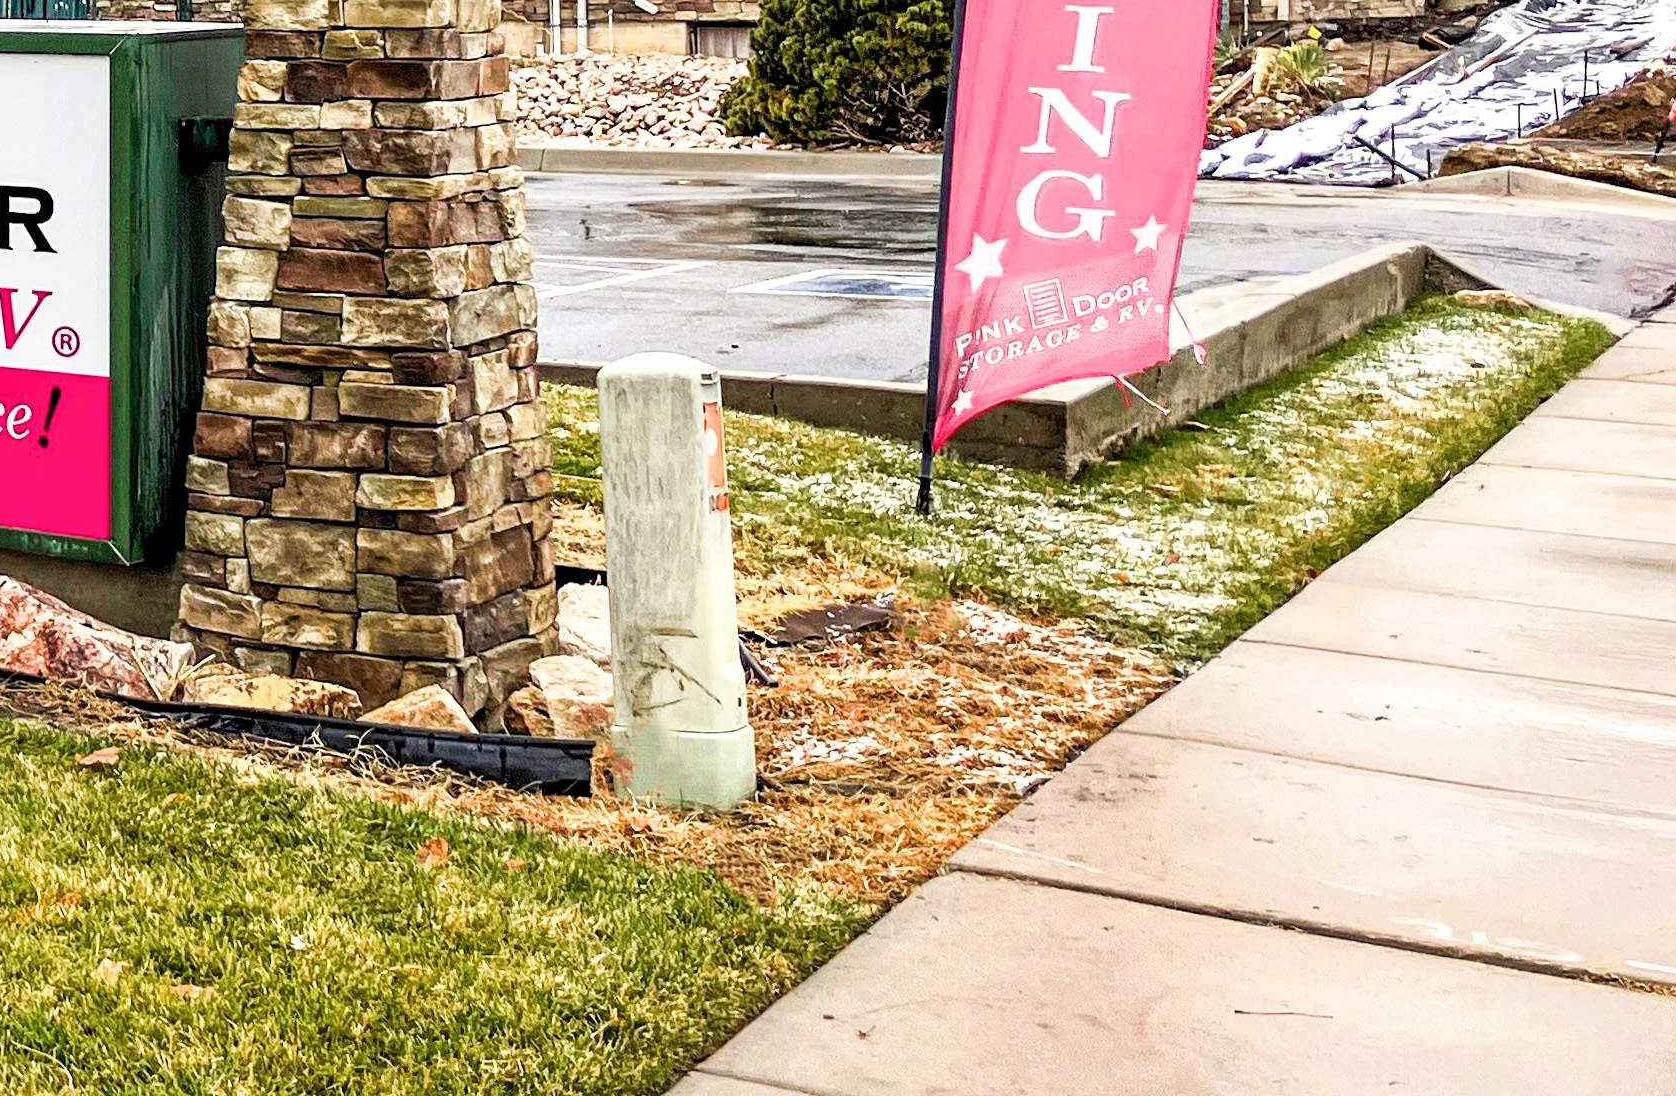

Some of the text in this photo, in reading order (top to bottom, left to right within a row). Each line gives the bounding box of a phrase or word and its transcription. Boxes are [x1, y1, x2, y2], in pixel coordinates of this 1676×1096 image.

[1072, 276, 1149, 318] DOOR
[958, 324, 1081, 379] STORAGE
[1090, 316, 1109, 333] &
